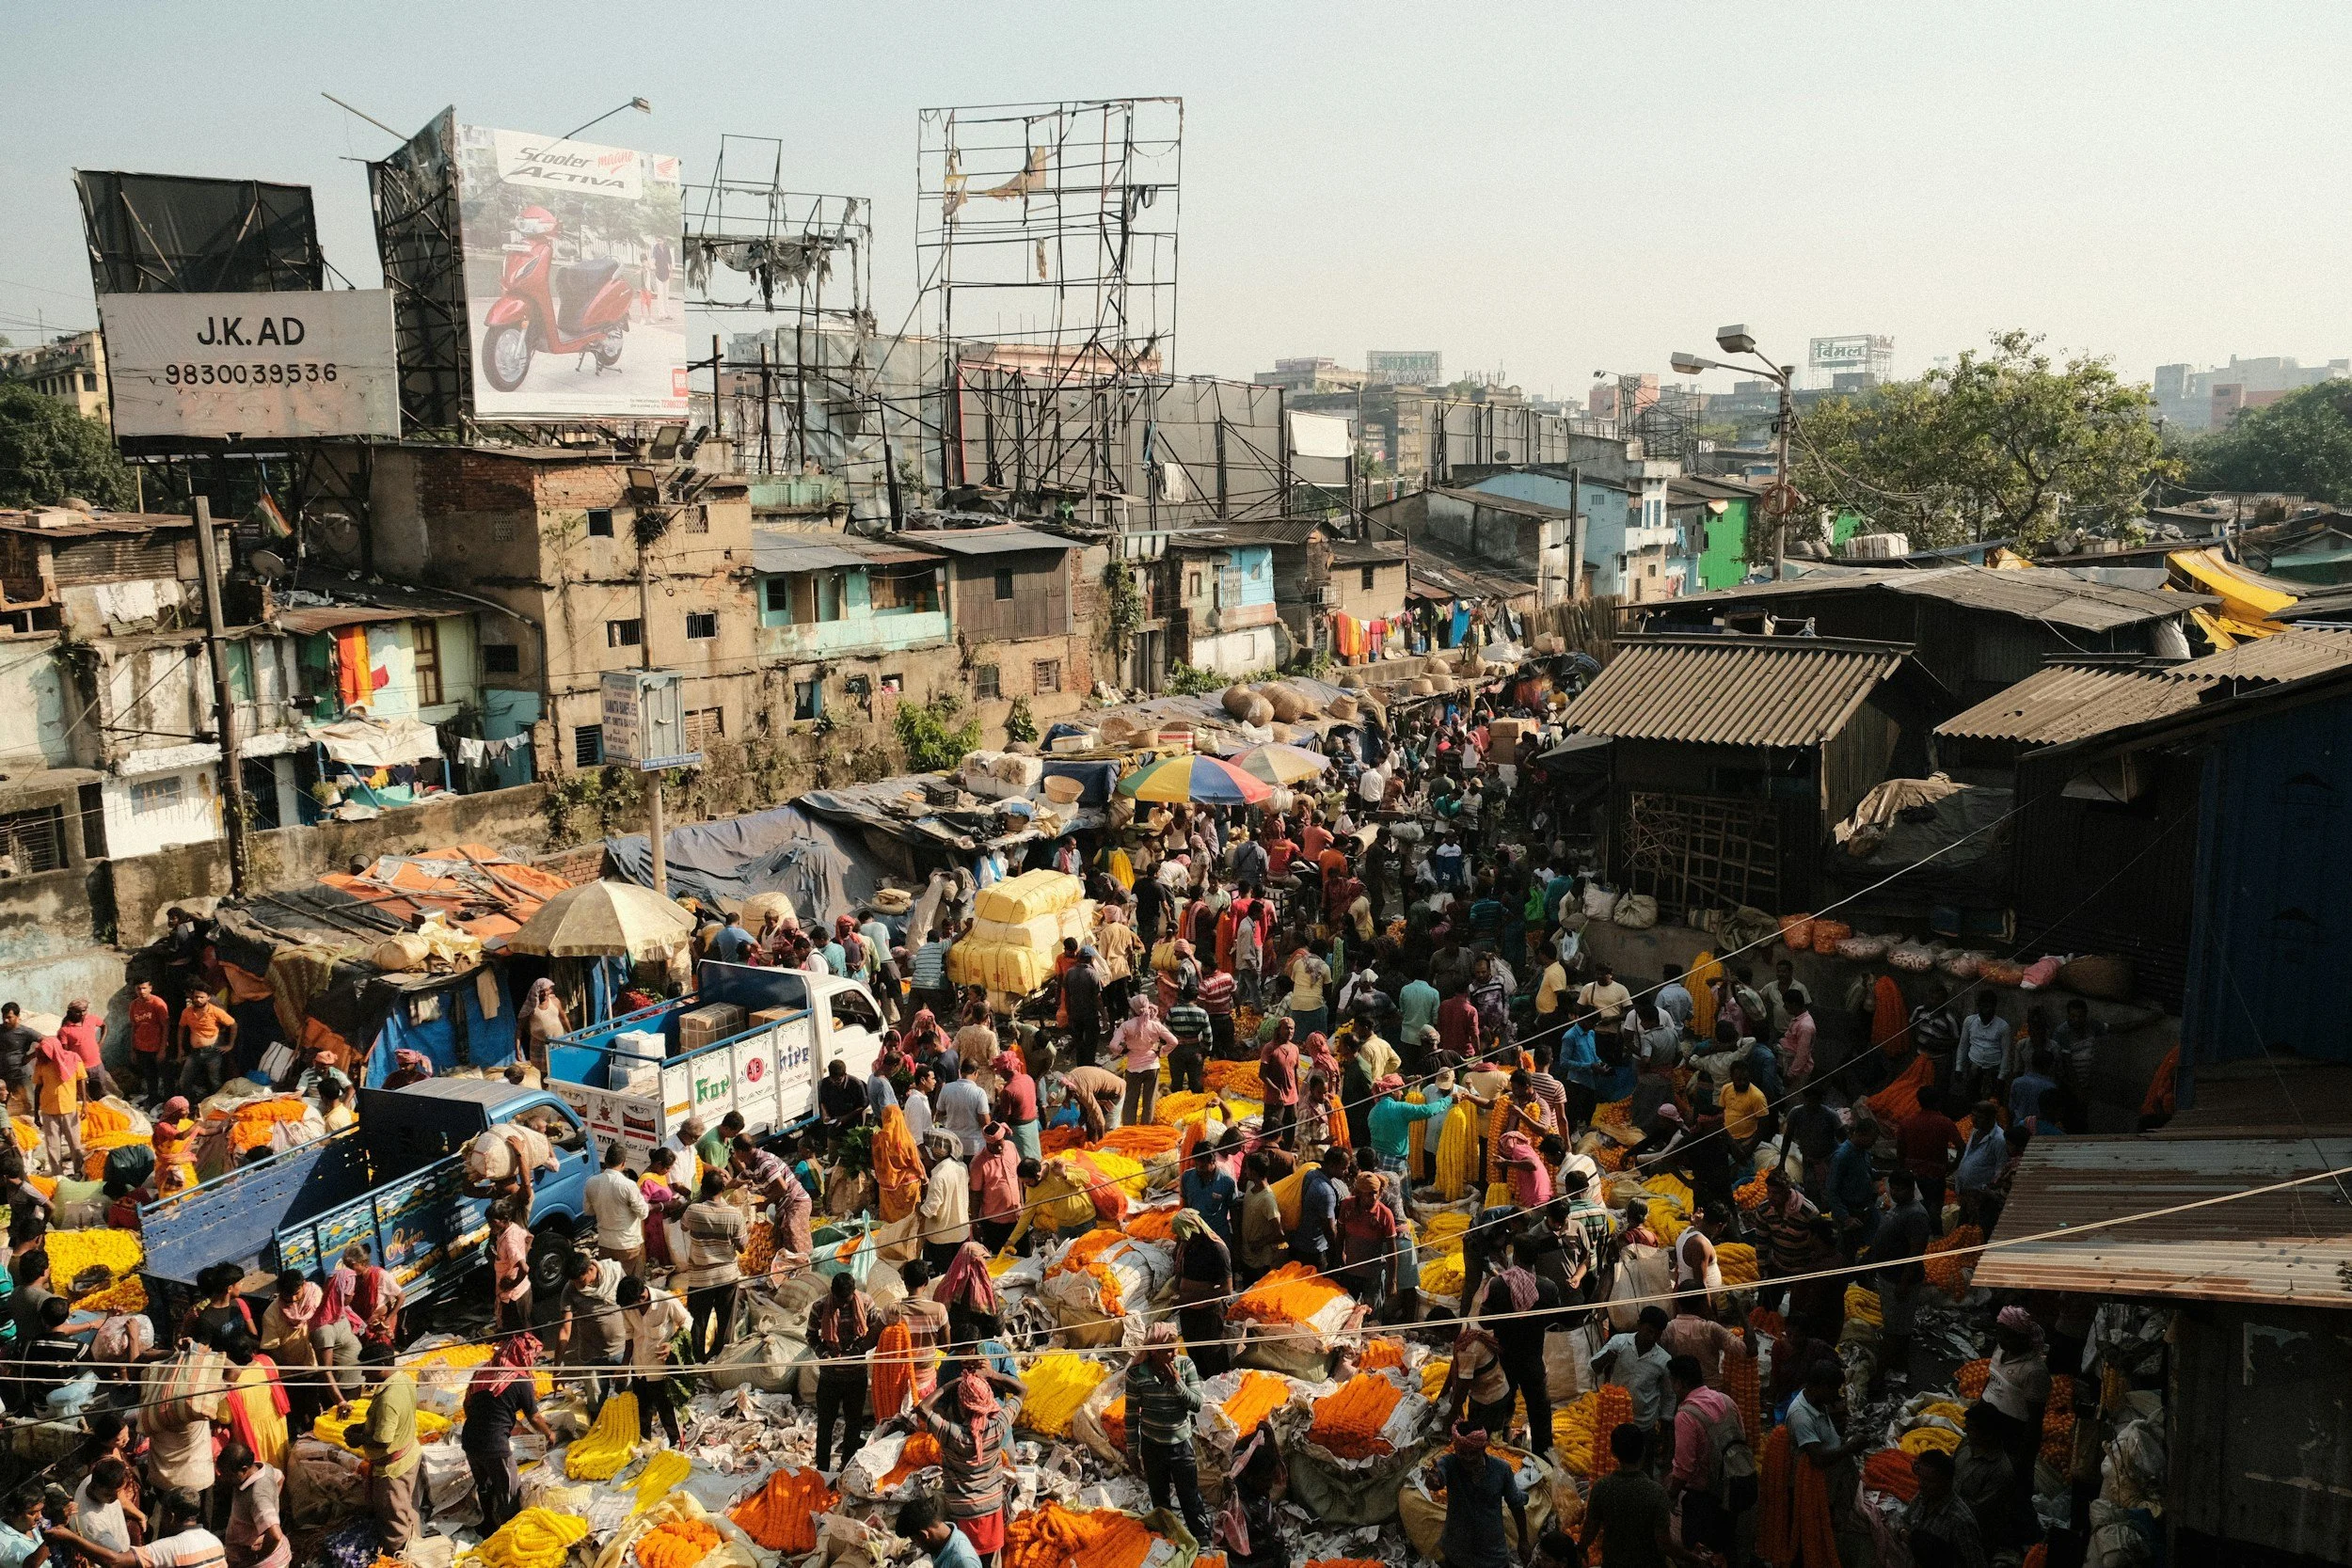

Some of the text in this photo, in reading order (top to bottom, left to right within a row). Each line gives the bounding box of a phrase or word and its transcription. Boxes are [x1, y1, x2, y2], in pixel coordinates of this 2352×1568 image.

[515, 147, 592, 168] Scooter
[198, 316, 305, 345] J.K. AD
[166, 363, 337, 385] 9830039536
